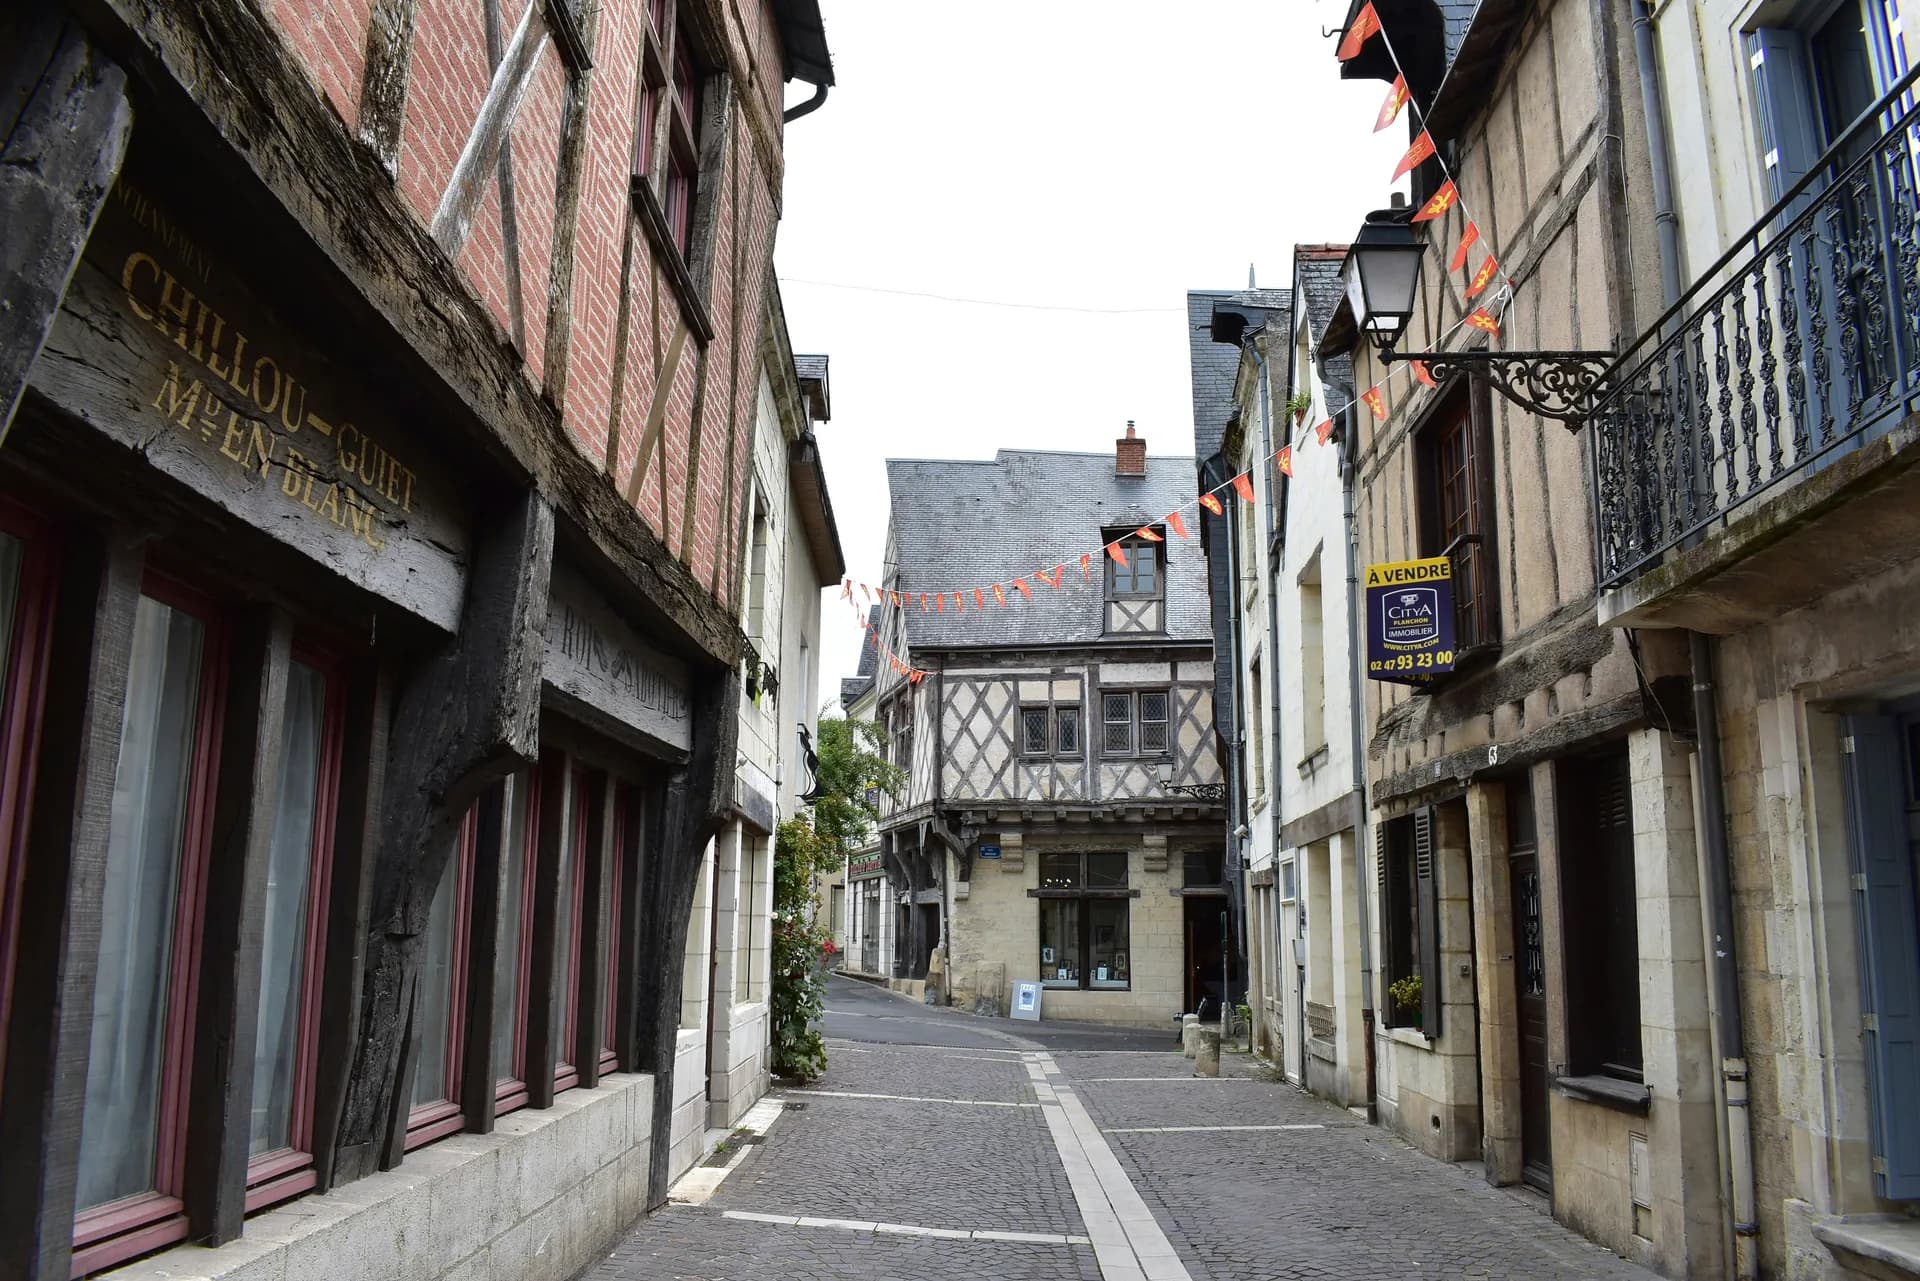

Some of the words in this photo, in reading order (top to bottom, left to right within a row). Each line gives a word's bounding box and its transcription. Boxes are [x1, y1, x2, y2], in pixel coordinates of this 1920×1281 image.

[219, 412, 278, 480] EN
[281, 446, 386, 551] BLANC
[1369, 569, 1379, 584] À
[1384, 564, 1449, 583] VENDRE
[1393, 617, 1429, 626] PLANCHON
[1388, 627, 1433, 638] IMMOBILIER
[1370, 661, 1382, 671] 02
[1384, 660, 1396, 670] 47
[1397, 655, 1413, 670] 93
[1416, 653, 1433, 667] 23
[1436, 650, 1453, 664] 00
